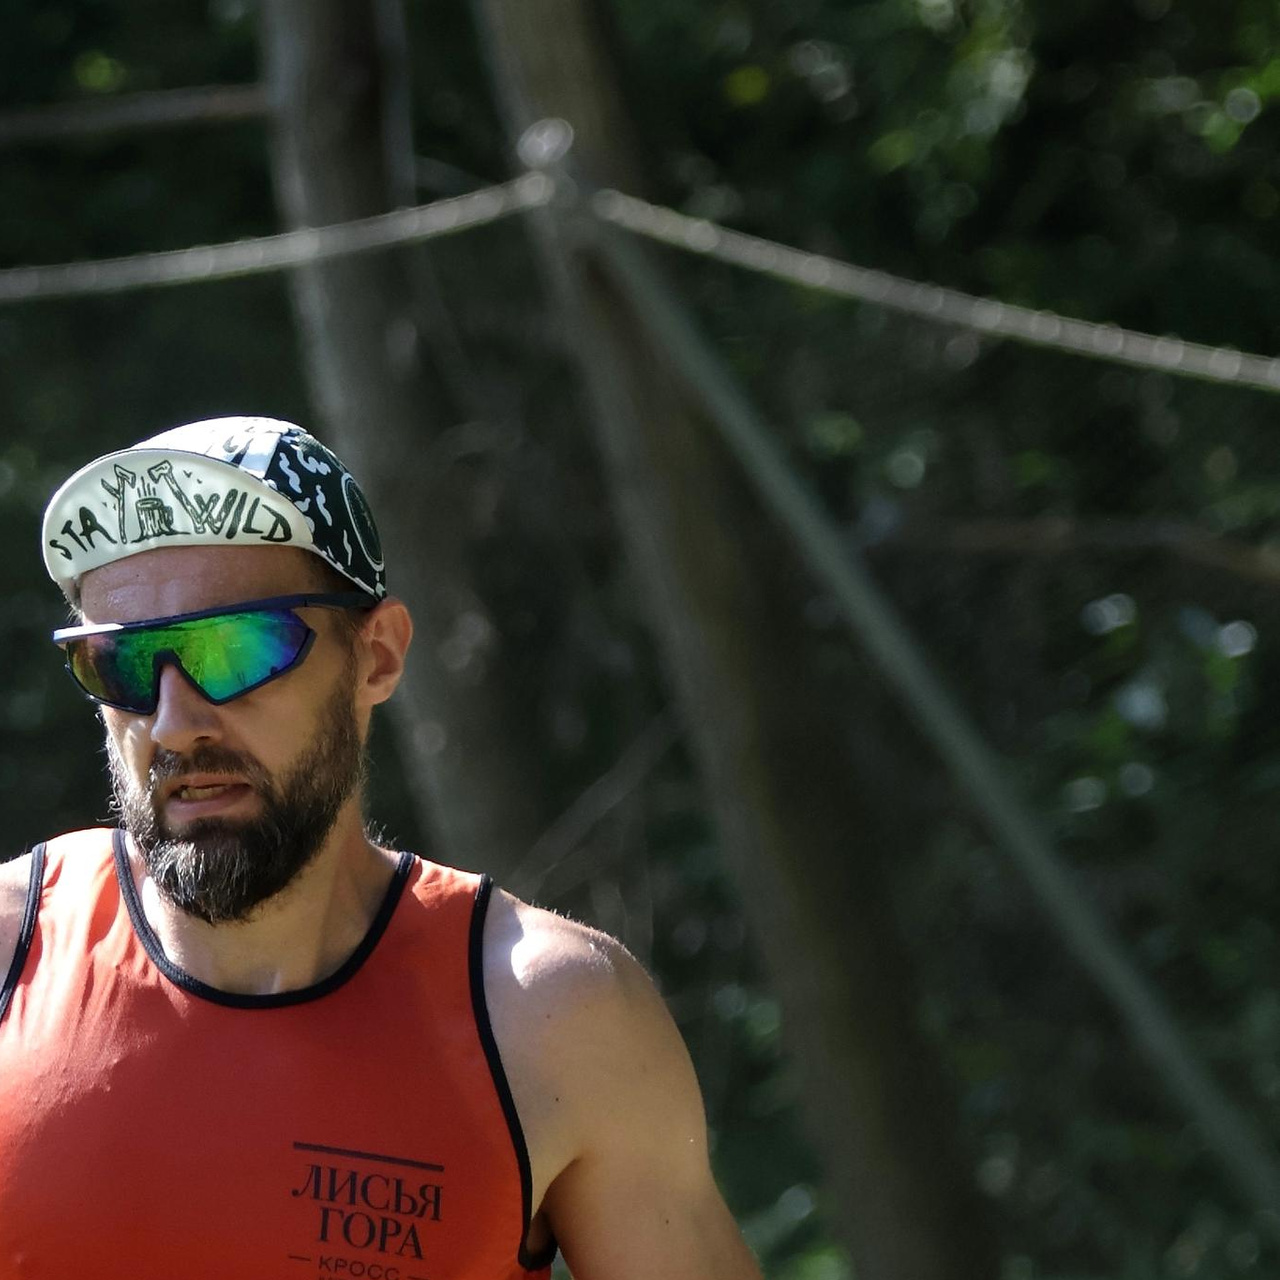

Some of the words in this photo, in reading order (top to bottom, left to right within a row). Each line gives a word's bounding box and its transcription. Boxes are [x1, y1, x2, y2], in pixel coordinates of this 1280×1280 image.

[193, 488, 293, 543] WILD
[291, 1164, 444, 1222] ЛИСЬЯ
[318, 1207, 424, 1260] ГОРА
